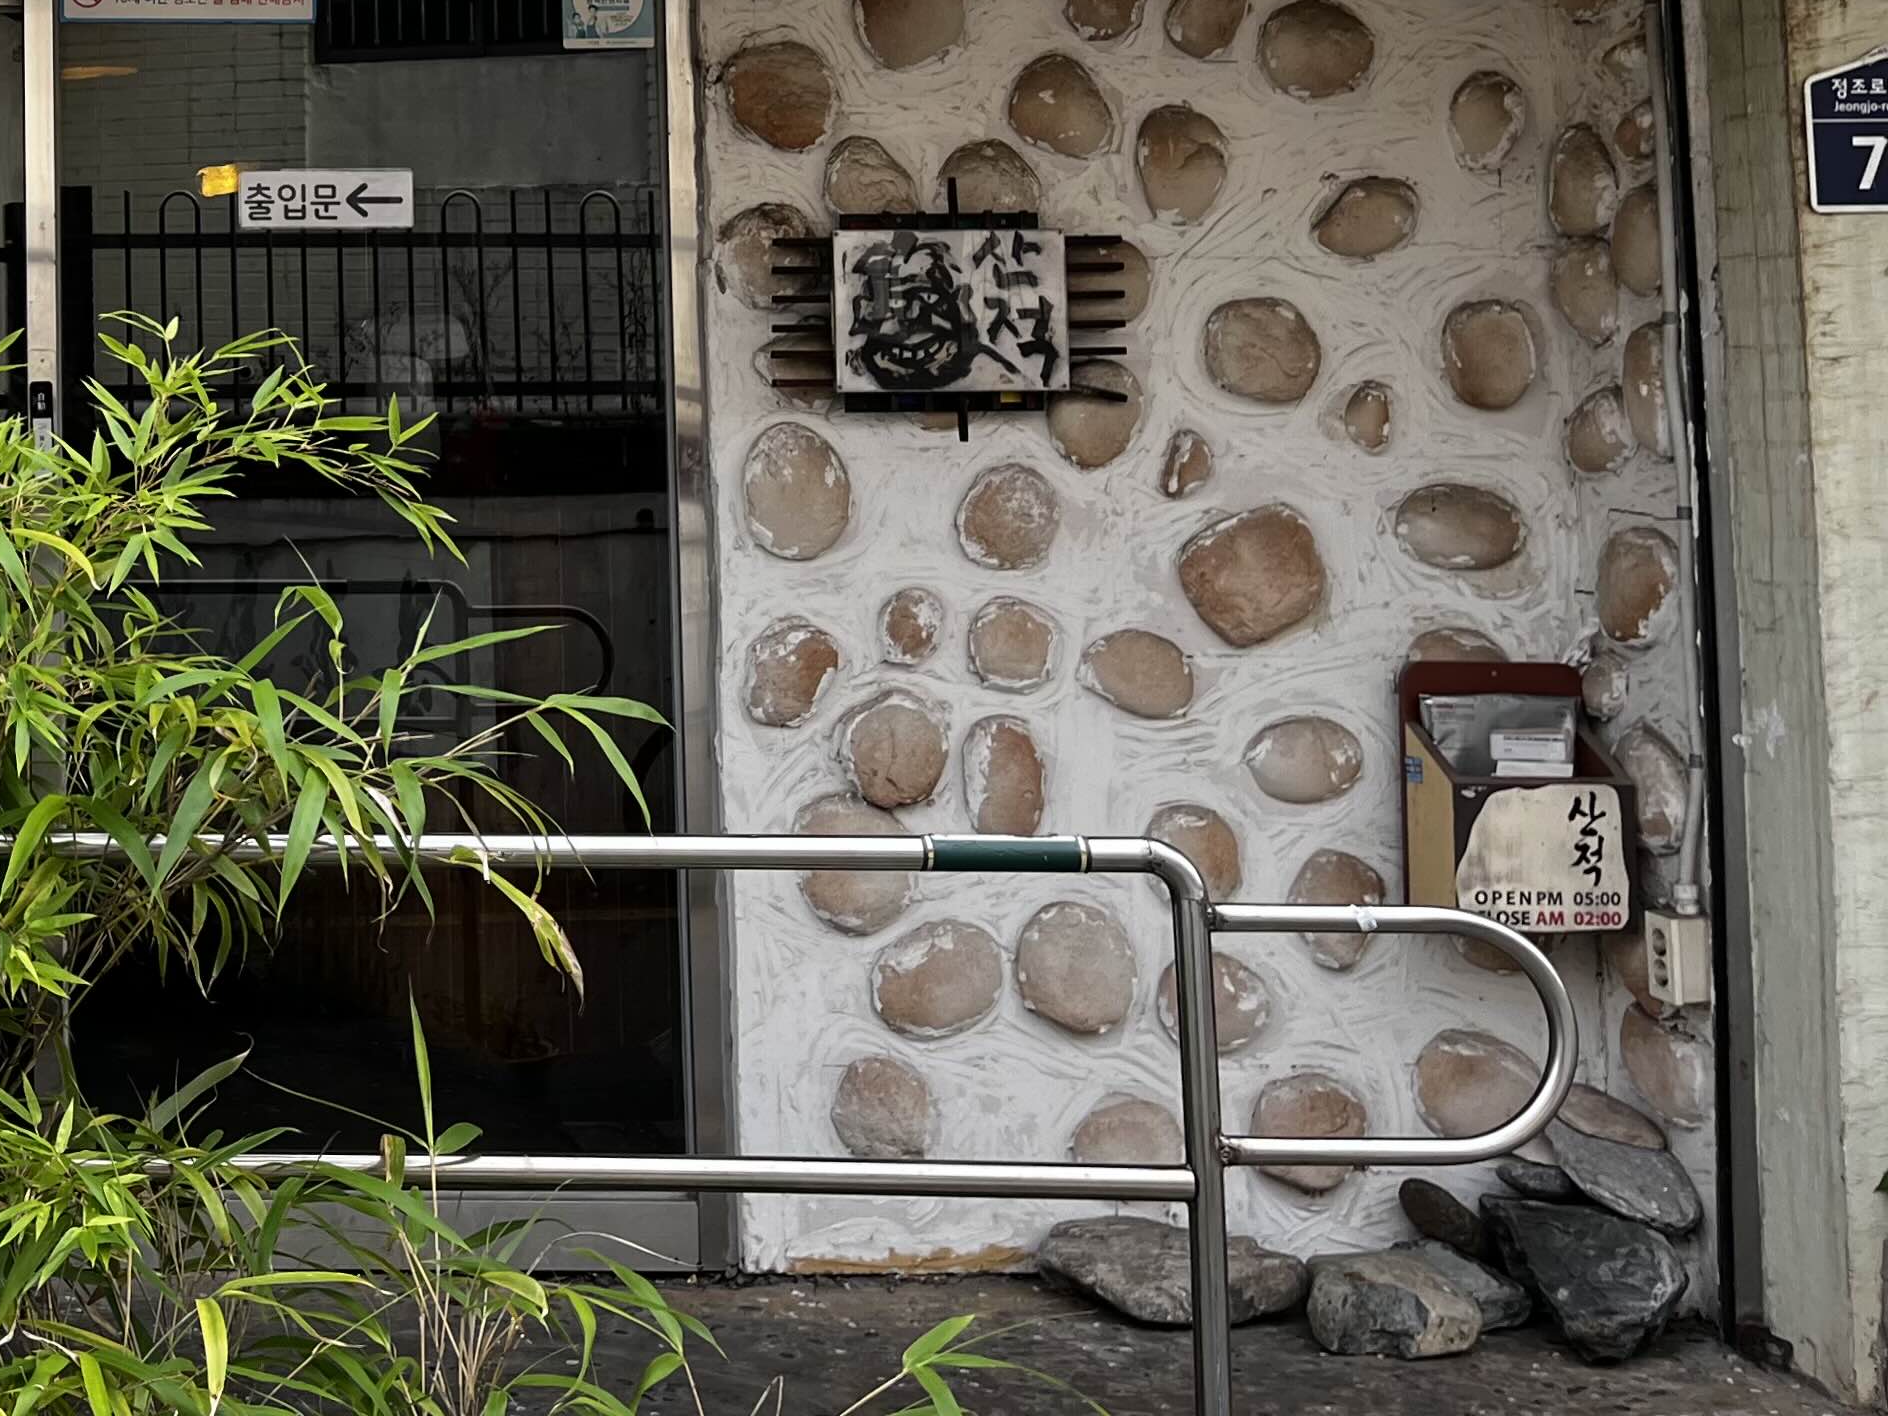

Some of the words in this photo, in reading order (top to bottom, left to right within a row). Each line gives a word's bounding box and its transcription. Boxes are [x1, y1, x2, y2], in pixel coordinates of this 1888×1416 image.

[1832, 78, 1887, 99] 정조로
[1852, 136, 1888, 190] 7
[244, 183, 341, 220] 출입문
[1568, 791, 1606, 886] 산적
[1475, 890, 1531, 905] OPEN
[1537, 891, 1563, 906] PM
[1574, 892, 1621, 906] 05:00
[1536, 911, 1564, 926] AM
[1574, 911, 1621, 926] 02:00
